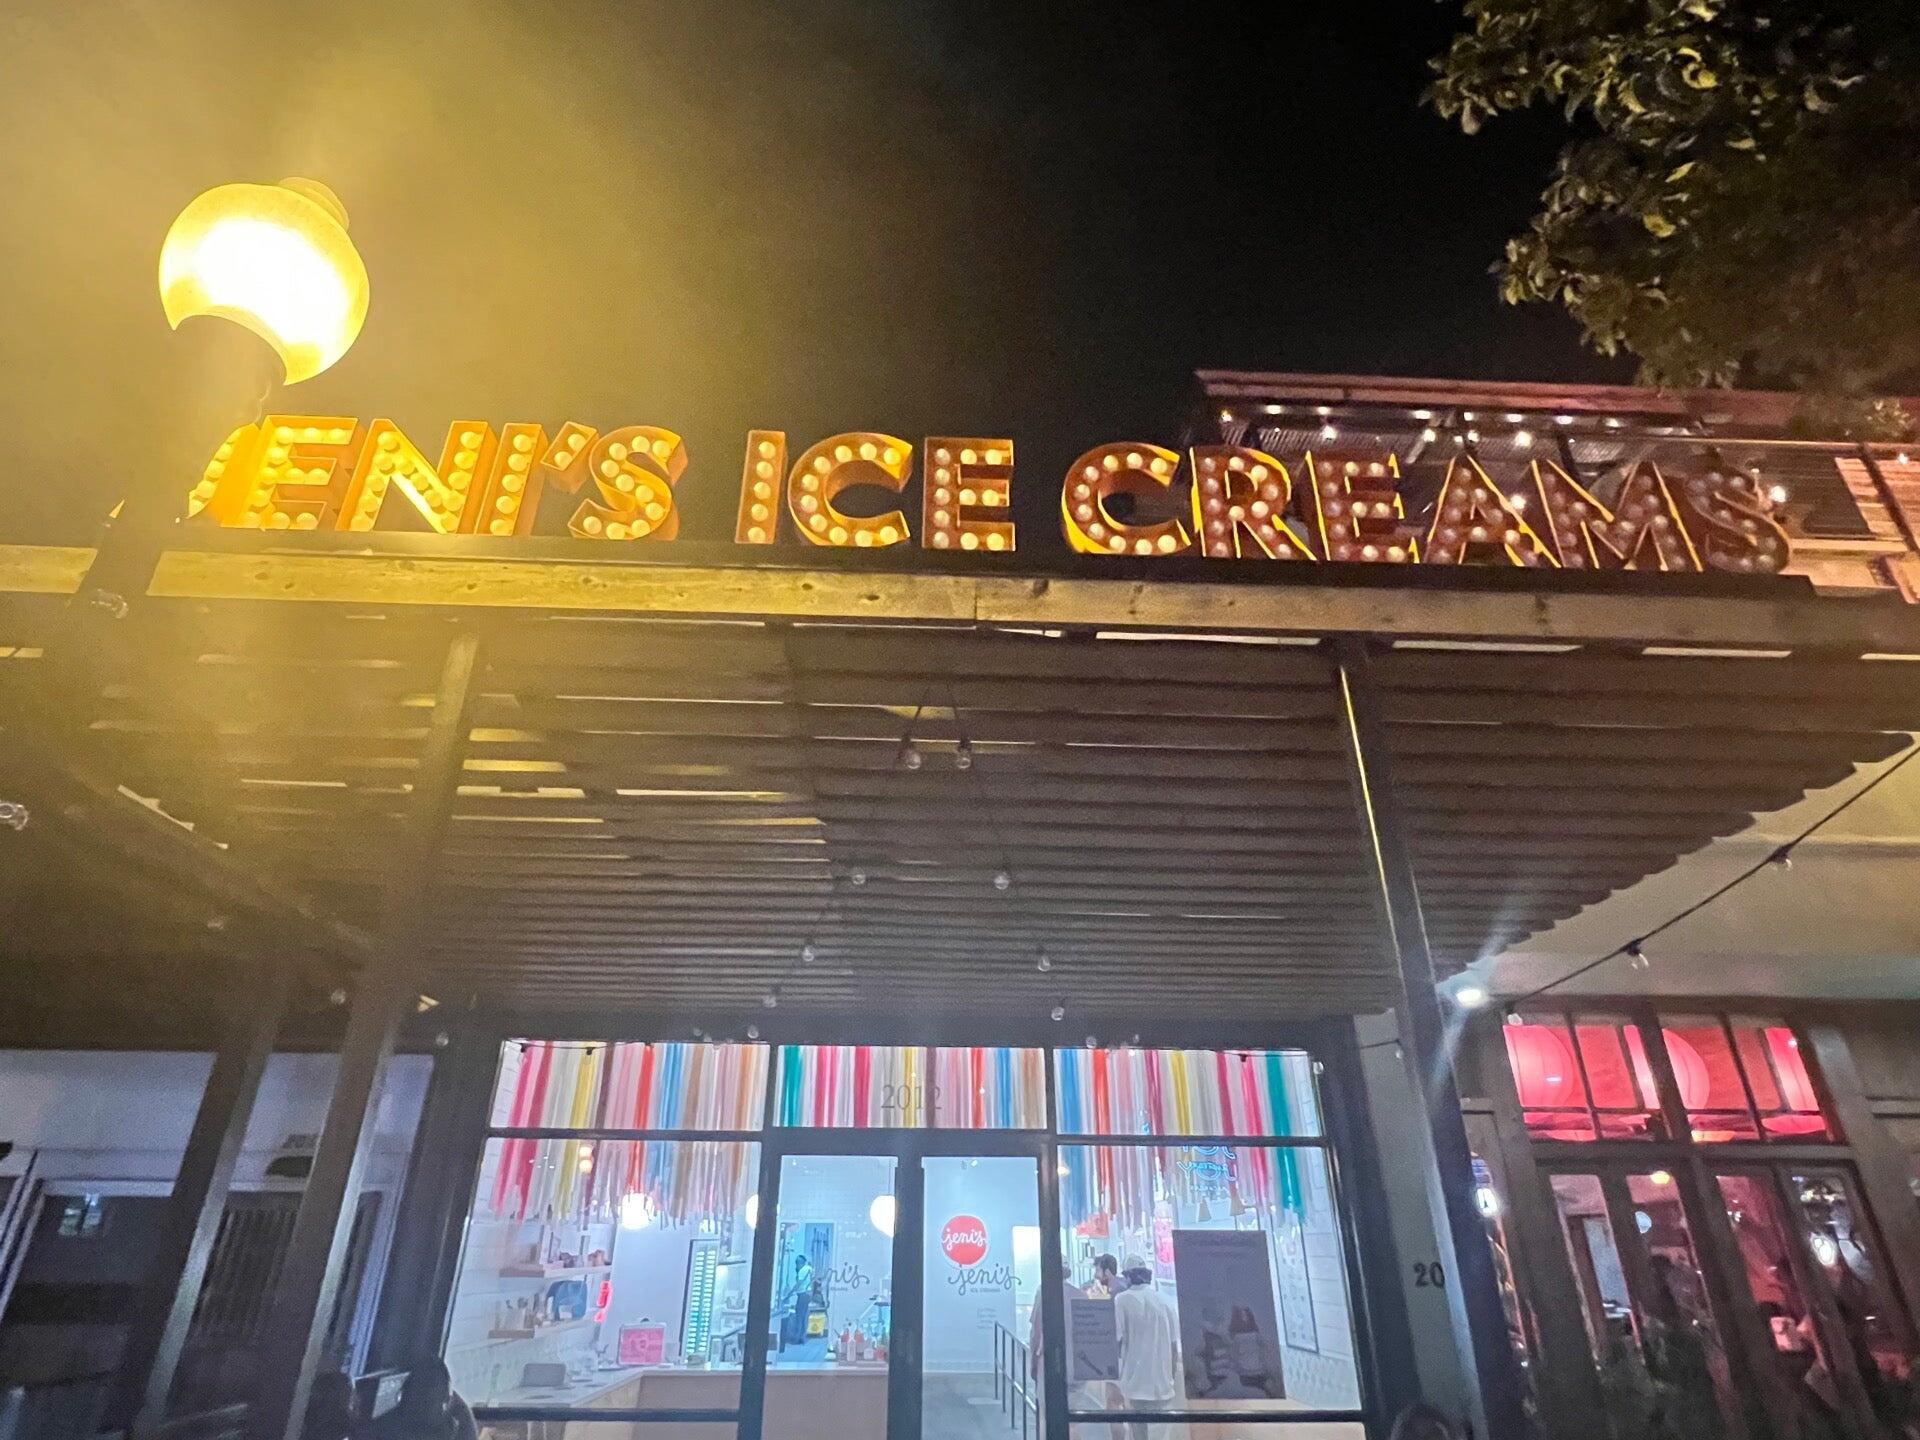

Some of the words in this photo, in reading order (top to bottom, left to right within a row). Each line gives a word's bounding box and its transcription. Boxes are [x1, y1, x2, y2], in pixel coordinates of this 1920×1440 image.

[734, 429, 1017, 552] ICE
[1061, 442, 1791, 574] CREAMS
[881, 1084, 943, 1110] 2012
[942, 1228, 988, 1251] jeni's
[948, 1263, 1023, 1297] jeni's
[1413, 1261, 1446, 1289] 20
